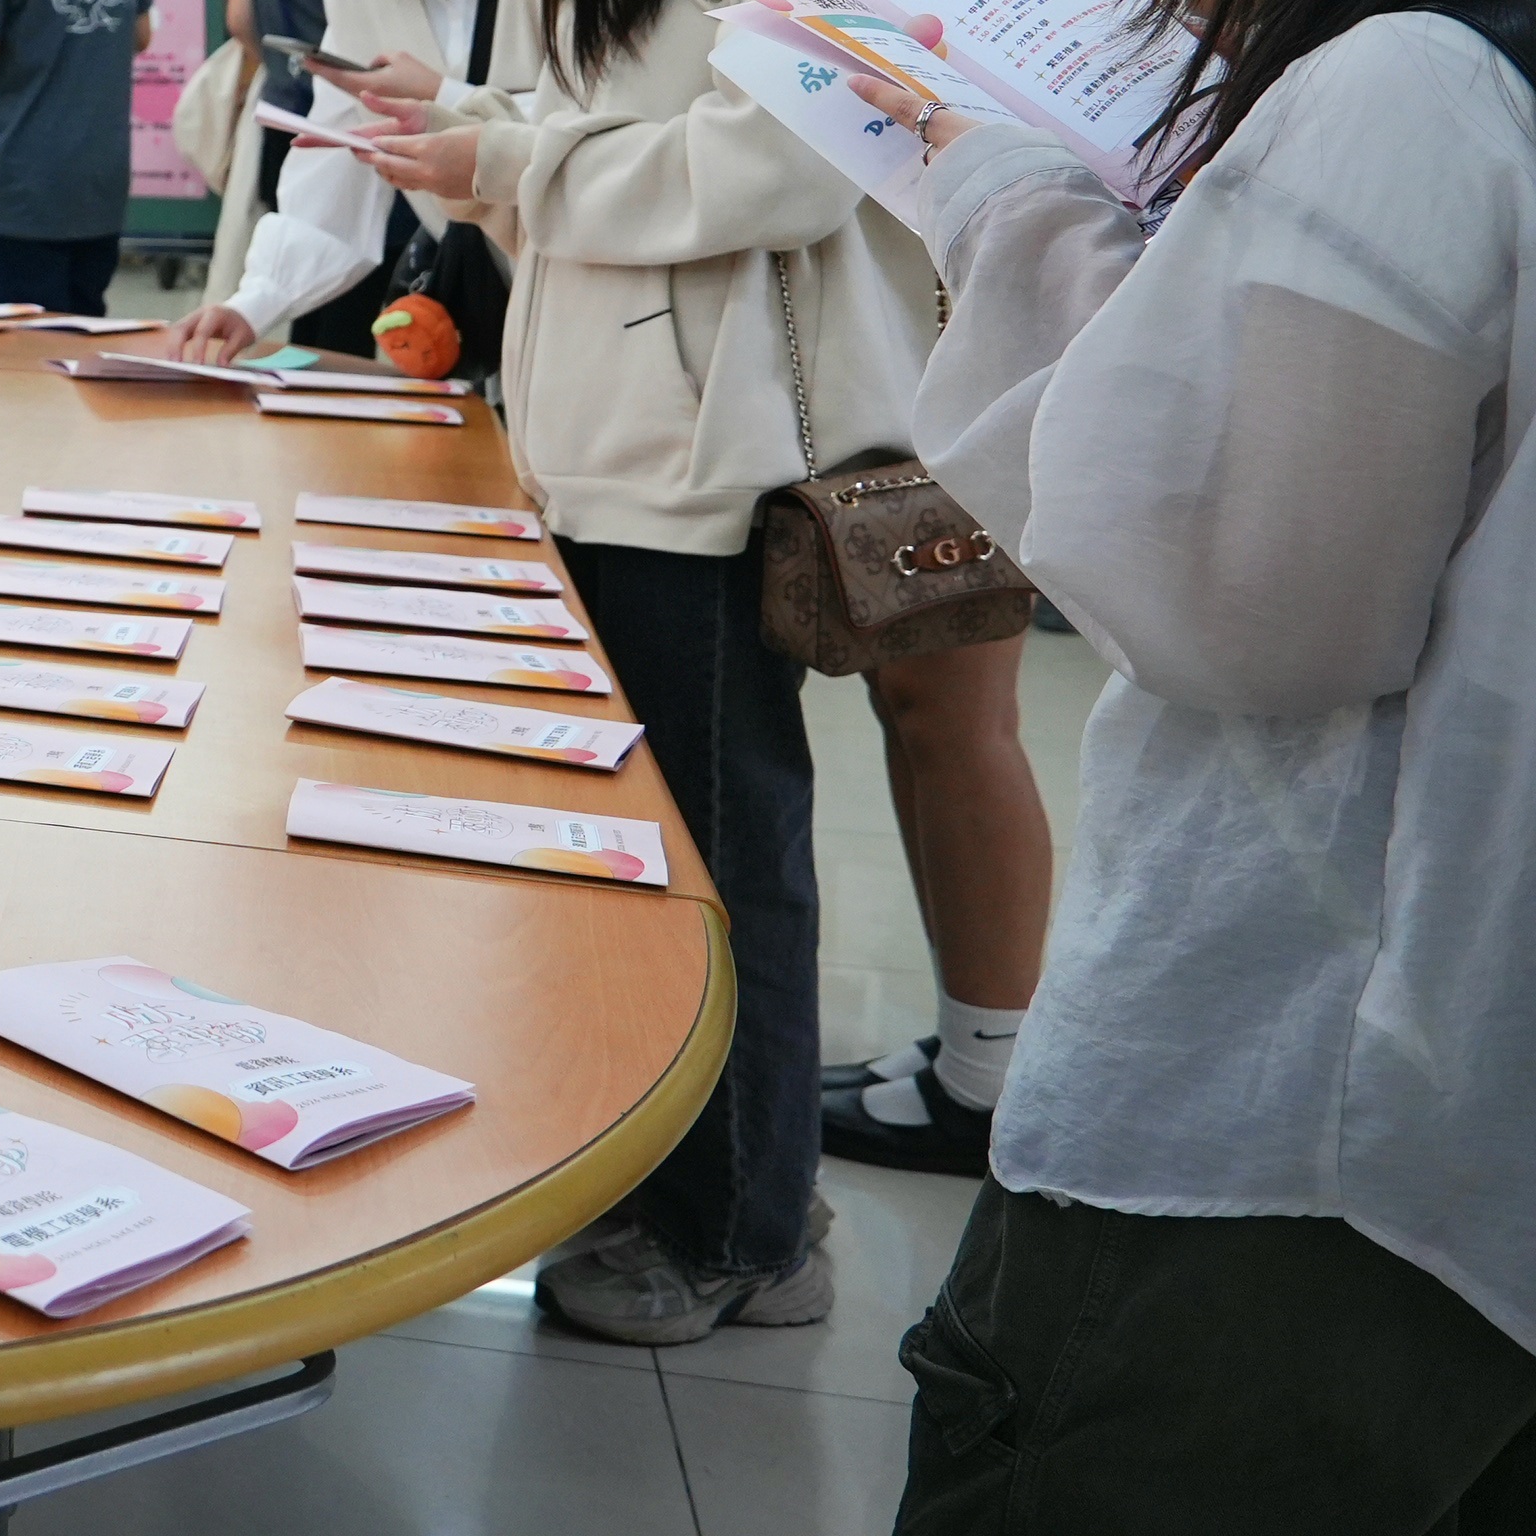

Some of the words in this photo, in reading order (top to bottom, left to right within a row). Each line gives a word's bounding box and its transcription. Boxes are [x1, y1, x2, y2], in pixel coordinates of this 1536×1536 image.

[1016, 18, 1050, 48] 分發入學
[1046, 40, 1083, 69] 繁星推薦
[235, 1055, 301, 1072] 電資學院
[244, 1065, 358, 1097] 資訊工程學系
[0, 1195, 125, 1250] 電機工程學系
